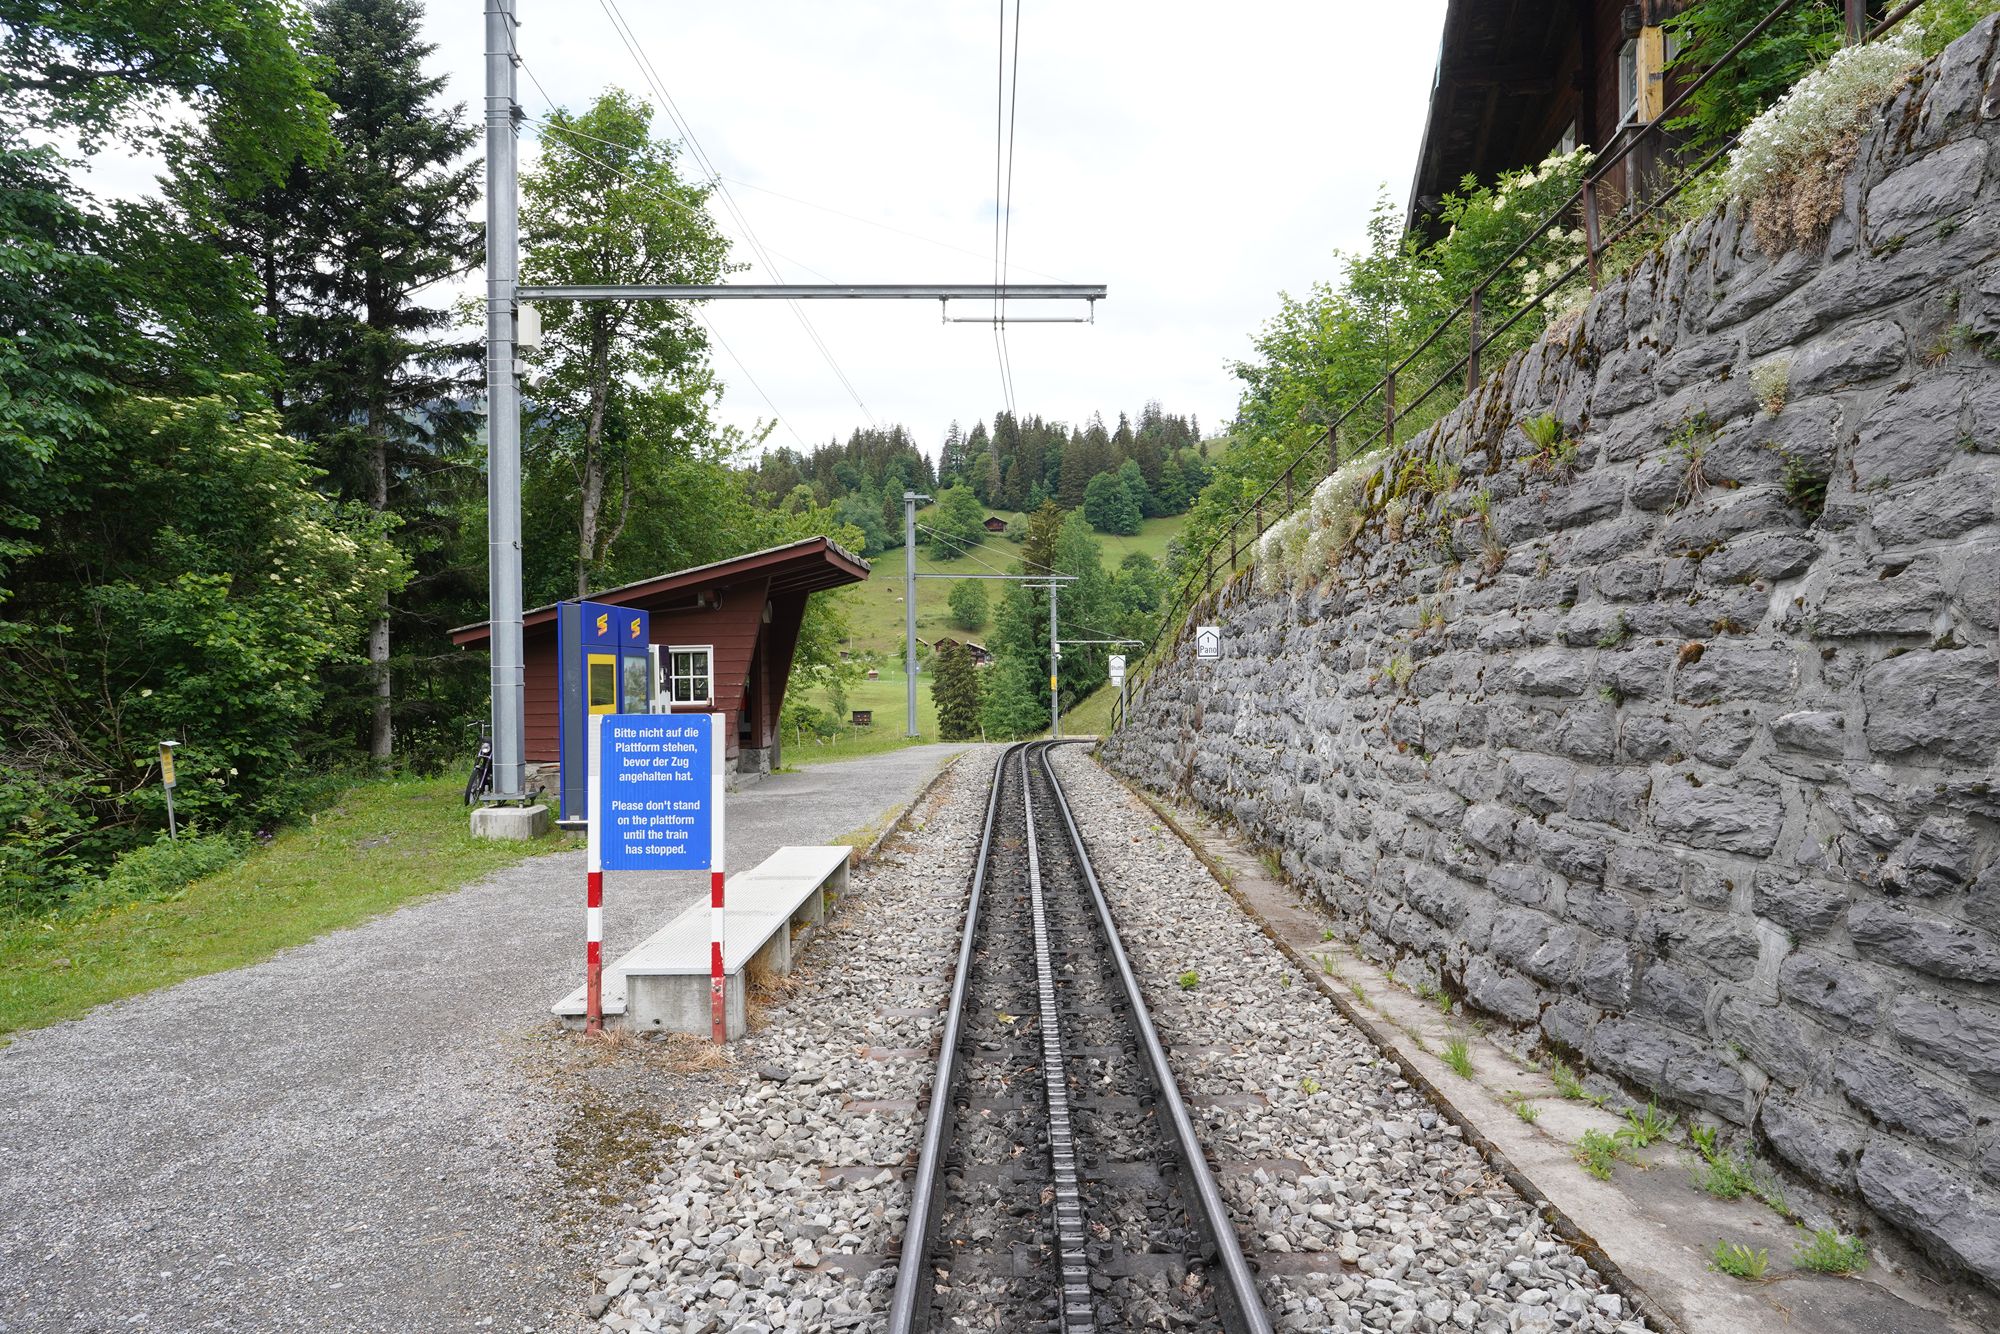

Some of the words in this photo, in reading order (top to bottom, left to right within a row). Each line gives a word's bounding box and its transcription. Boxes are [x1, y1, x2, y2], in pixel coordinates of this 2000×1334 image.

[1200, 645, 1217, 654] Pano
[614, 727, 637, 738] Bitte
[639, 727, 664, 738] nicht
[665, 727, 682, 738] auf
[684, 727, 699, 738] die
[615, 742, 660, 752] Plattform
[662, 742, 698, 753] stehen,
[623, 756, 650, 767] bevor
[652, 756, 669, 767] der
[671, 756, 689, 768] Zug
[619, 771, 673, 783] angehalten
[675, 771, 694, 781] hat.
[612, 800, 644, 811] Please
[646, 800, 671, 810] don't
[673, 800, 700, 810] stand
[617, 816, 630, 825] on
[632, 815, 648, 825] the
[650, 815, 695, 827] plattform
[623, 829, 646, 840] until
[647, 829, 664, 840] the
[665, 829, 688, 840] train
[625, 844, 643, 855] has
[645, 844, 687, 856] stopped.
